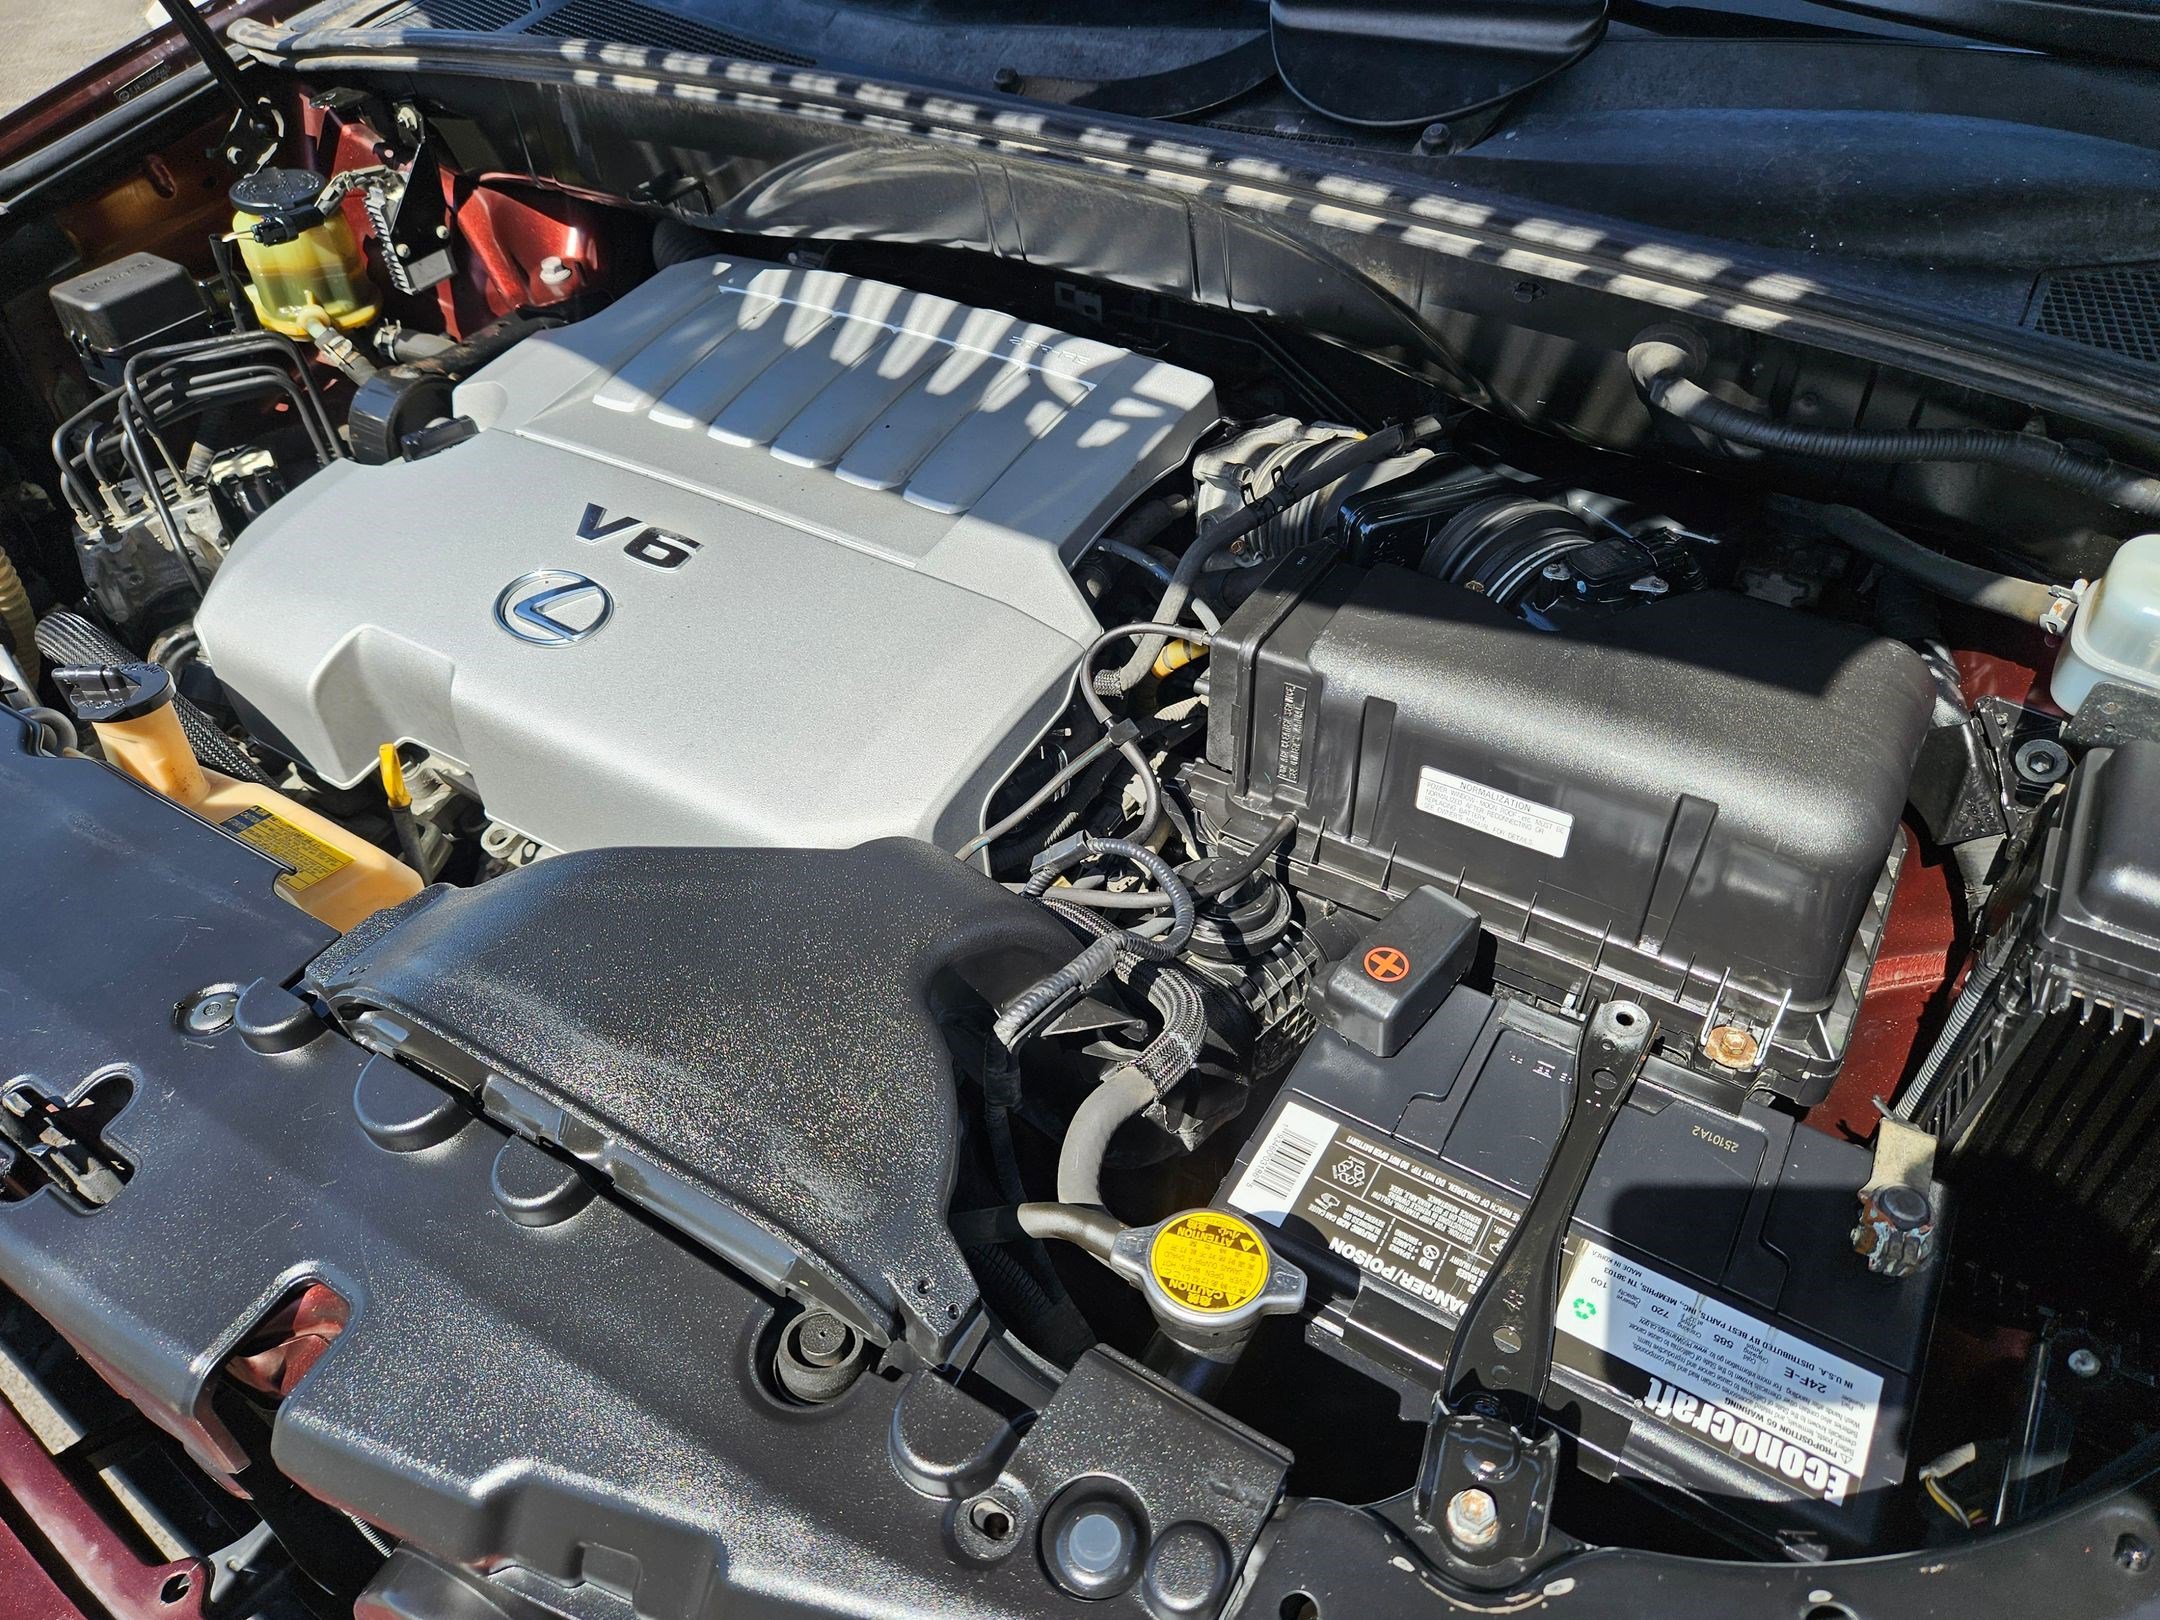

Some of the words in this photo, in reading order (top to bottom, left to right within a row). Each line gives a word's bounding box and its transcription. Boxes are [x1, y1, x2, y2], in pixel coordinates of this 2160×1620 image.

[575, 502, 704, 573] V6
[1459, 781, 1531, 811] NORMALIZATION
[1465, 802, 1484, 813] AFTER
[1486, 810, 1532, 830] RECONNECTING
[1345, 1134, 1374, 1153] BATTERY!
[1688, 1125, 1740, 1153] 25101A2
[1372, 1146, 1390, 1160] OPEN
[1387, 1154, 1401, 1165] NOT
[1399, 1159, 1410, 1170] DO
[1408, 1164, 1422, 1176] TIP.
[1420, 1169, 1436, 1182] NOT
[1434, 1176, 1446, 1187] DO
[1388, 1183, 1403, 1195] SEEK
[1445, 1181, 1481, 1203] CHILDREN.
[1370, 1190, 1394, 1206] FOLLOW
[1479, 1197, 1490, 1208] OF
[1306, 1202, 1326, 1217] CAUSE
[1341, 1211, 1352, 1220] OR
[1344, 1203, 1365, 1218] BURNS
[1409, 1201, 1432, 1216] VEHICLE
[1430, 1203, 1443, 1214] NOT
[1430, 1211, 1438, 1219] IN
[1442, 1209, 1449, 1217] IF
[1447, 1211, 1456, 1220] OR
[1489, 1202, 1512, 1218] REACH
[1324, 1211, 1337, 1222] CAN
[1335, 1216, 1351, 1229] ACID
[1363, 1212, 1386, 1228] SEVERE
[1418, 1213, 1435, 1226] JUMP
[1455, 1215, 1479, 1231] MANUAL
[1458, 1208, 1482, 1225] SERVICE
[1350, 1215, 1381, 1235] BLINDNESS
[1433, 1220, 1446, 1231] FOR
[1437, 1214, 1476, 1238] INSTRUCTIONS
[1491, 1224, 1509, 1238] FAST.
[1176, 1226, 1234, 1247] ATTENTION
[1349, 1223, 1378, 1243] SULFURIC
[1393, 1228, 1419, 1245] SMOKING
[1446, 1226, 1473, 1244] CAUTION:
[1391, 1235, 1415, 1252] FLAMES
[1388, 1243, 1411, 1259] SPARKS
[1591, 1249, 1613, 1263] KOREA
[1180, 1263, 1201, 1273] WHEN
[1417, 1255, 1433, 1270] NO
[1448, 1254, 1471, 1270] INJURY
[1613, 1260, 1621, 1268] IN
[1204, 1269, 1224, 1280] OPEN
[1454, 1266, 1477, 1284] GASES
[1470, 1264, 1480, 1275] OR
[1603, 1266, 1626, 1282] 38103
[1621, 1263, 1642, 1277] MADE
[1228, 1275, 1252, 1287] NEVER
[1590, 1275, 1607, 1288] 100
[1627, 1278, 1637, 1287] TN
[1168, 1278, 1224, 1300] CAUTION
[1617, 1288, 1641, 1303] Capacity
[1638, 1282, 1677, 1305] MEMPHIS,
[1615, 1293, 1638, 1308] Reserve
[1677, 1300, 1696, 1315] INC.,
[1650, 1304, 1670, 1318] 720
[1697, 1309, 1726, 1329] PARTS,
[1646, 1330, 1663, 1342] cause
[1676, 1321, 1702, 1338] Cranking
[1727, 1324, 1748, 1339] BEST
[1636, 1335, 1652, 1348] harm.
[1662, 1338, 1669, 1346] to
[1712, 1333, 1733, 1349] 585
[1749, 1335, 1760, 1345] BY
[1630, 1341, 1664, 1363] compounds,
[1652, 1342, 1686, 1364] reproductive
[1669, 1341, 1695, 1359] California
[1742, 1346, 1769, 1363] Cranking
[1745, 1342, 1763, 1355] Amps
[1761, 1341, 1815, 1370] DISTRIBUTED
[1663, 1358, 1675, 1369] lead
[1685, 1358, 1697, 1369] and
[1694, 1354, 1702, 1362] of
[1701, 1357, 1716, 1369] State
[1715, 1353, 1724, 1362] go
[1742, 1353, 1756, 1364] Cold
[1676, 1364, 1687, 1375] and
[1687, 1369, 1700, 1381] lead
[1697, 1364, 1716, 1377] cancer
[1716, 1364, 1727, 1374] the
[1723, 1358, 1756, 1379] information
[1726, 1369, 1733, 1377] to
[1817, 1367, 1842, 1383] U.S.A.
[1699, 1375, 1720, 1391] contain
[1716, 1373, 1733, 1386] cause
[1732, 1382, 1740, 1390] to
[1733, 1373, 1753, 1387] known
[1756, 1373, 1772, 1385] more
[1772, 1381, 1782, 1391] For
[1782, 1366, 1827, 1394] 24F-E
[1843, 1379, 1853, 1388] IN
[1720, 1385, 1753, 1406] accessories
[1740, 1385, 1766, 1403] California
[1753, 1382, 1781, 1401] chemicals
[1723, 1396, 1764, 1421] WARNING
[1773, 1401, 1789, 1414] State
[1781, 1395, 1797, 1408] other
[1797, 1403, 1820, 1419] contain
[1765, 1417, 1777, 1428] 65
[1806, 1417, 1827, 1432] known
[1639, 1375, 1851, 1507] Econocraft
[1779, 1423, 1837, 1457] PROPOSITION
